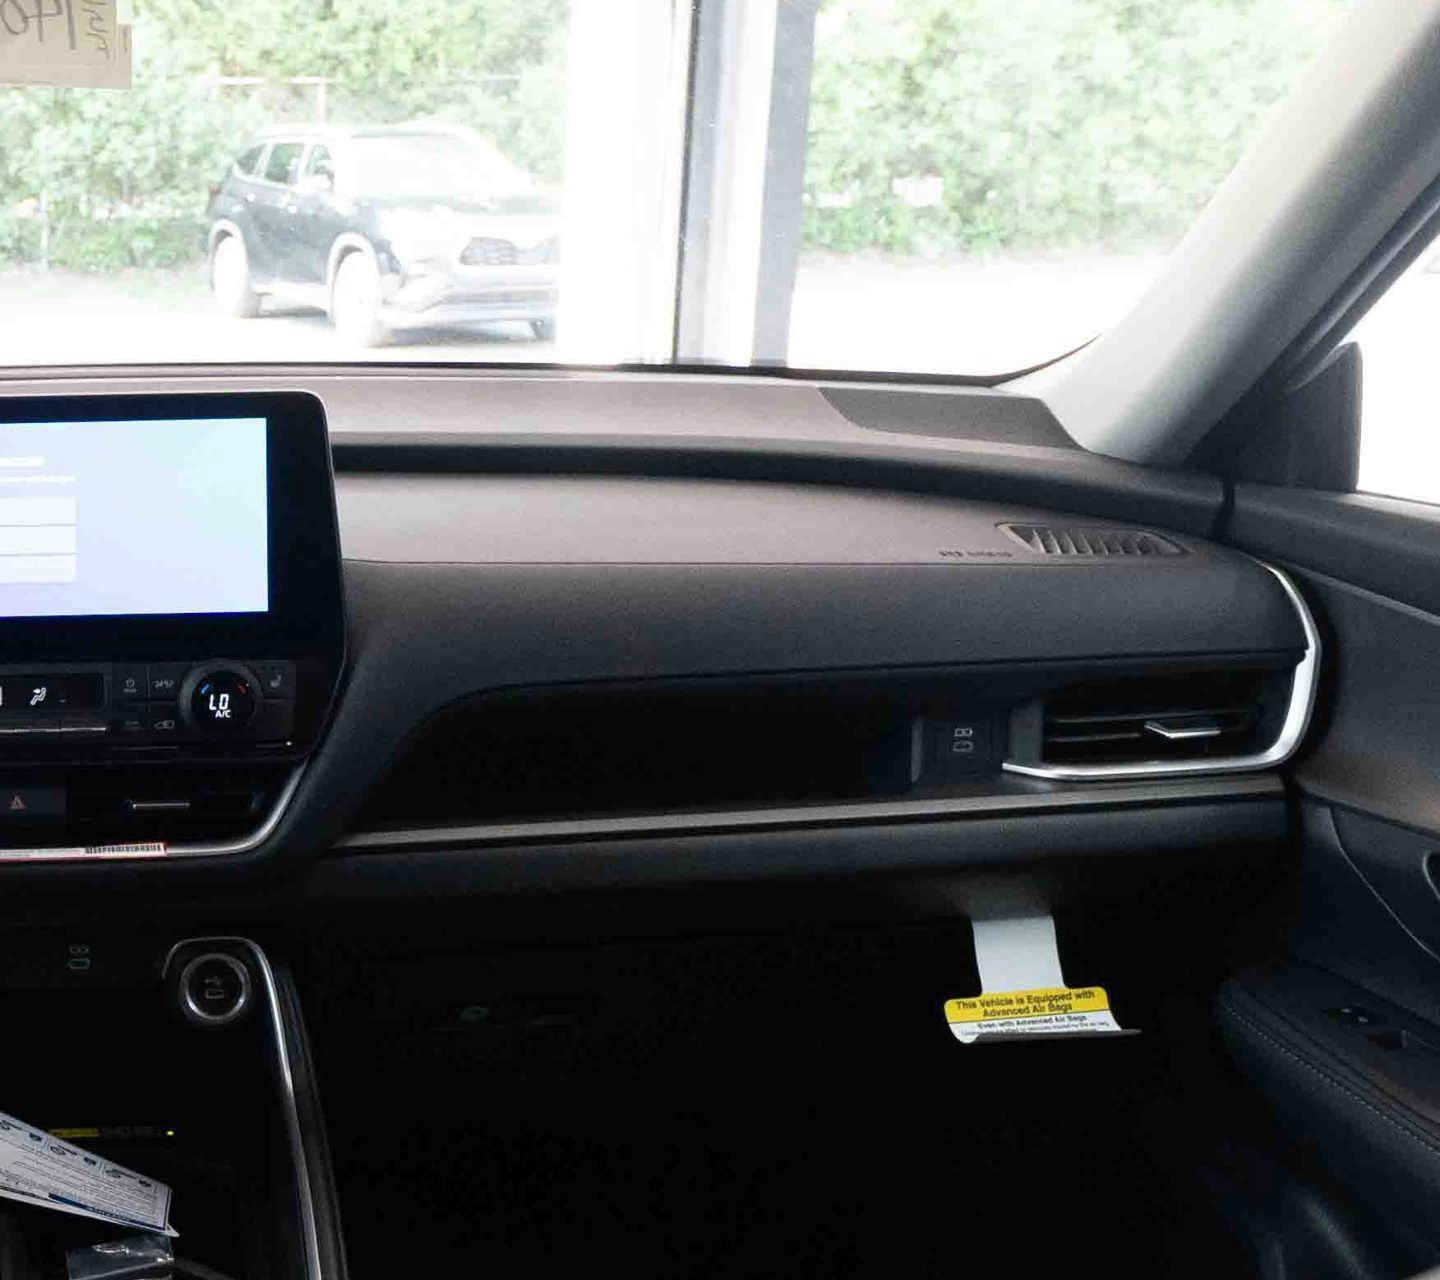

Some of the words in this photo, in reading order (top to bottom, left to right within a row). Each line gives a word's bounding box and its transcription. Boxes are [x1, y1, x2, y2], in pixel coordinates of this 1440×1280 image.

[214, 708, 232, 719] A/C
[956, 999, 978, 1010] This
[979, 996, 1014, 1009] Vehicle
[1015, 995, 1025, 1006] is
[1026, 991, 1073, 1007] Equipped
[1074, 990, 1096, 1001] with
[982, 1005, 1031, 1019] Advanced
[1032, 1003, 1046, 1014] Air
[1048, 1001, 1074, 1015] Bags
